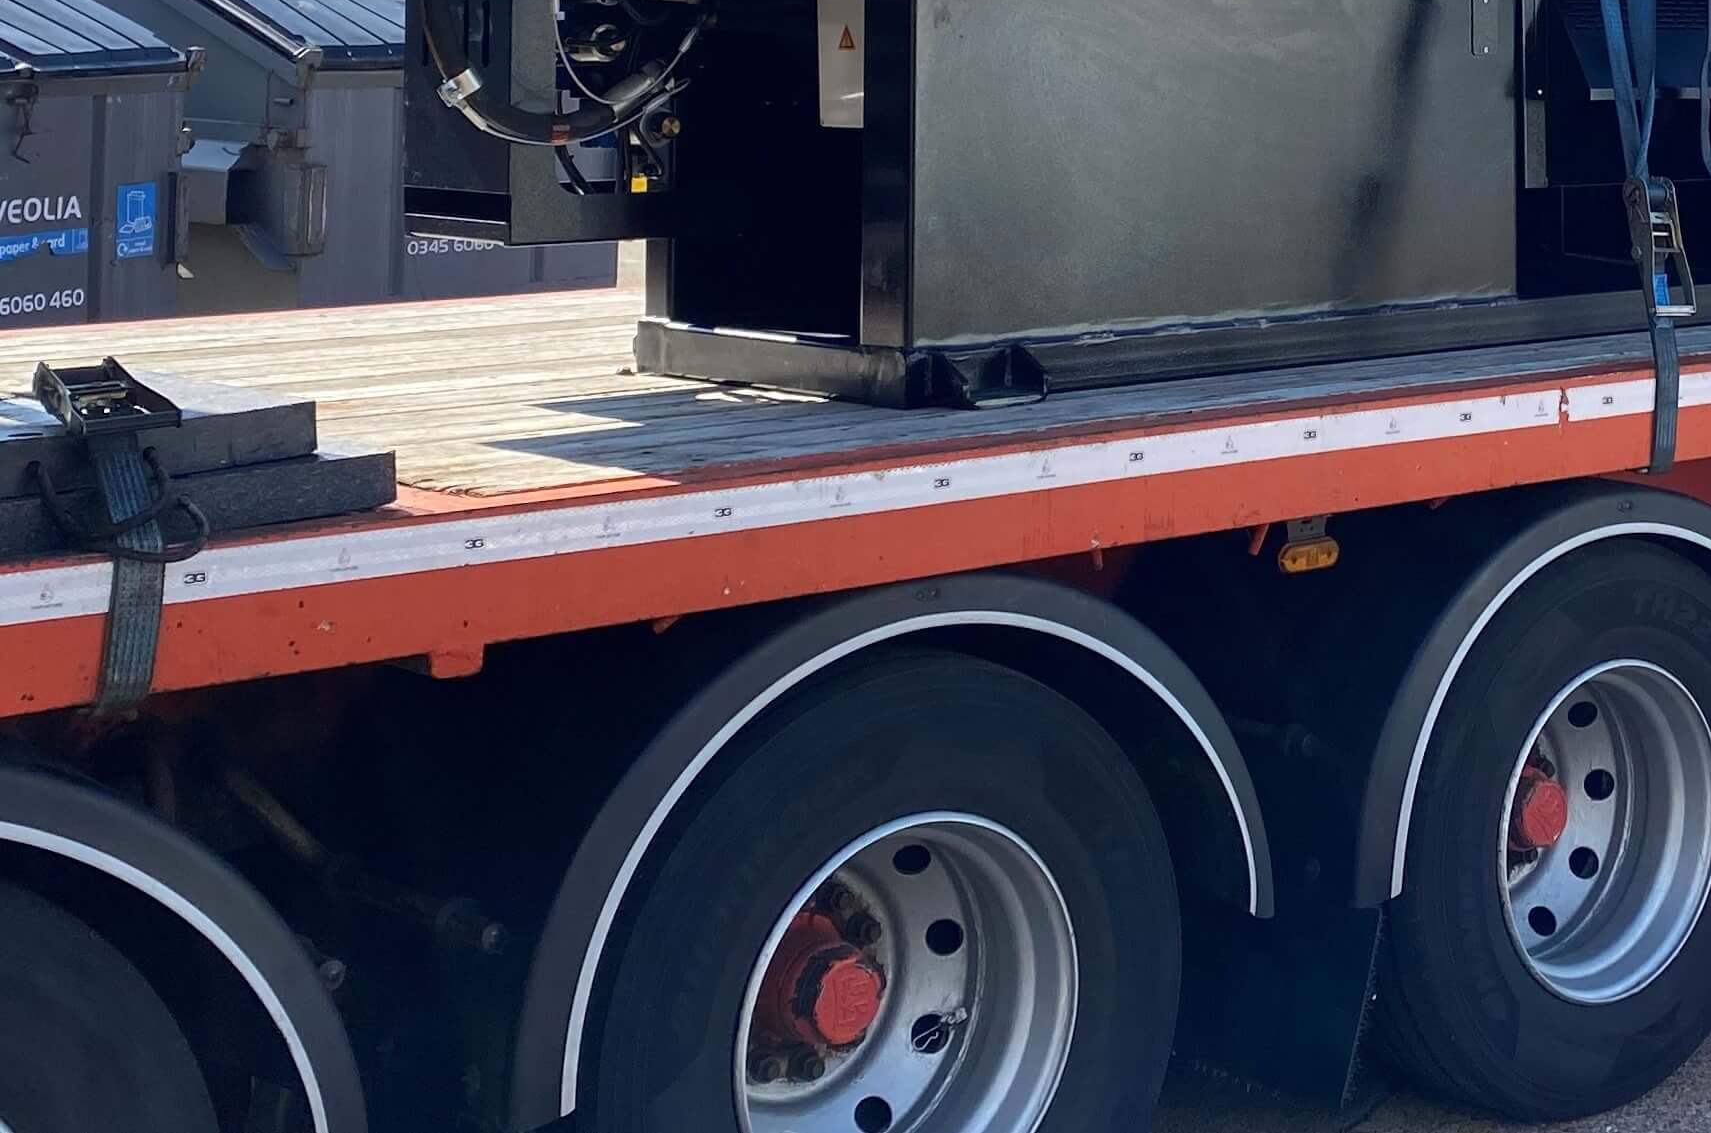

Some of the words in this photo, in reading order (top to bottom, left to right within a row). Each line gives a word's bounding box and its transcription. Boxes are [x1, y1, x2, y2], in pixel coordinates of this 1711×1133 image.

[407, 241, 448, 255] 0345
[0, 293, 46, 315] 6060
[49, 288, 84, 309] 460
[464, 538, 485, 550] 3G
[183, 572, 206, 585] 3G
